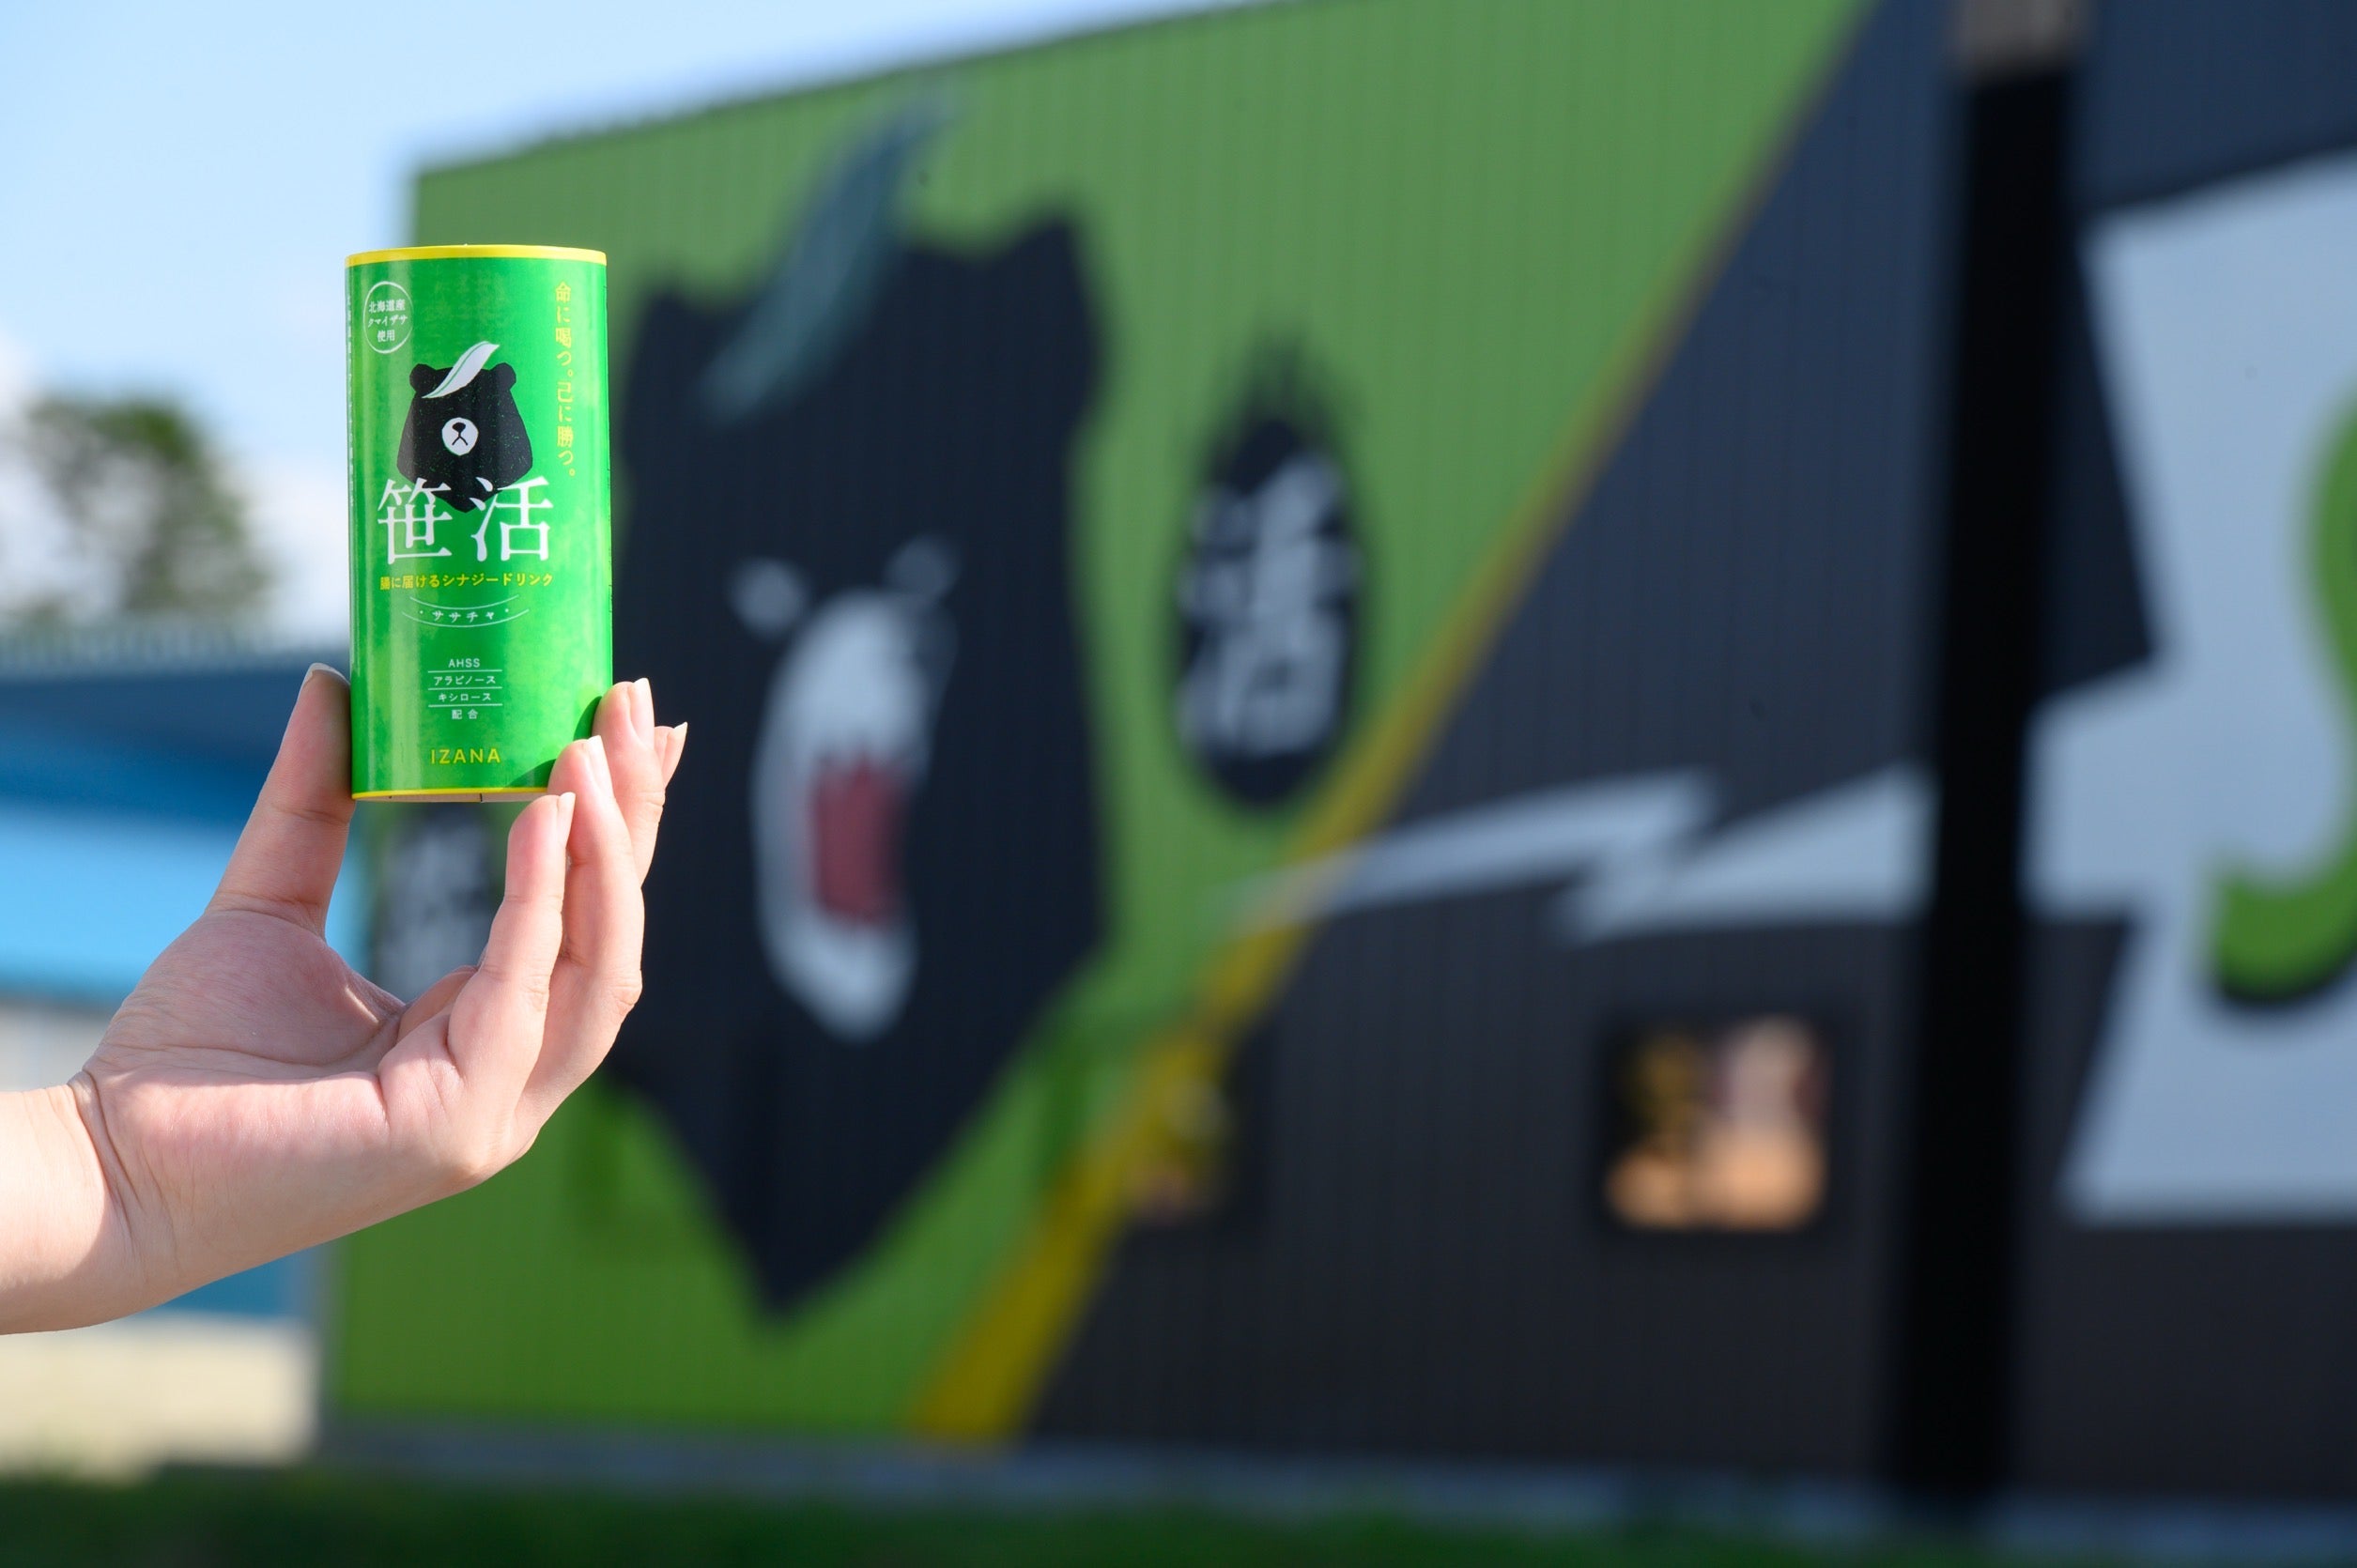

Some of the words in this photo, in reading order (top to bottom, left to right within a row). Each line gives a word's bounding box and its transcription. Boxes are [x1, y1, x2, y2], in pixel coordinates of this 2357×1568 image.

[369, 299, 406, 314] 北海道産
[367, 315, 408, 328] クマイザサ
[377, 330, 395, 343] 使用
[377, 476, 554, 564] 笹活
[448, 658, 481, 668] AHSS
[438, 692, 492, 702] キシロース
[451, 709, 479, 720] 配合
[430, 748, 502, 764] IZANA
